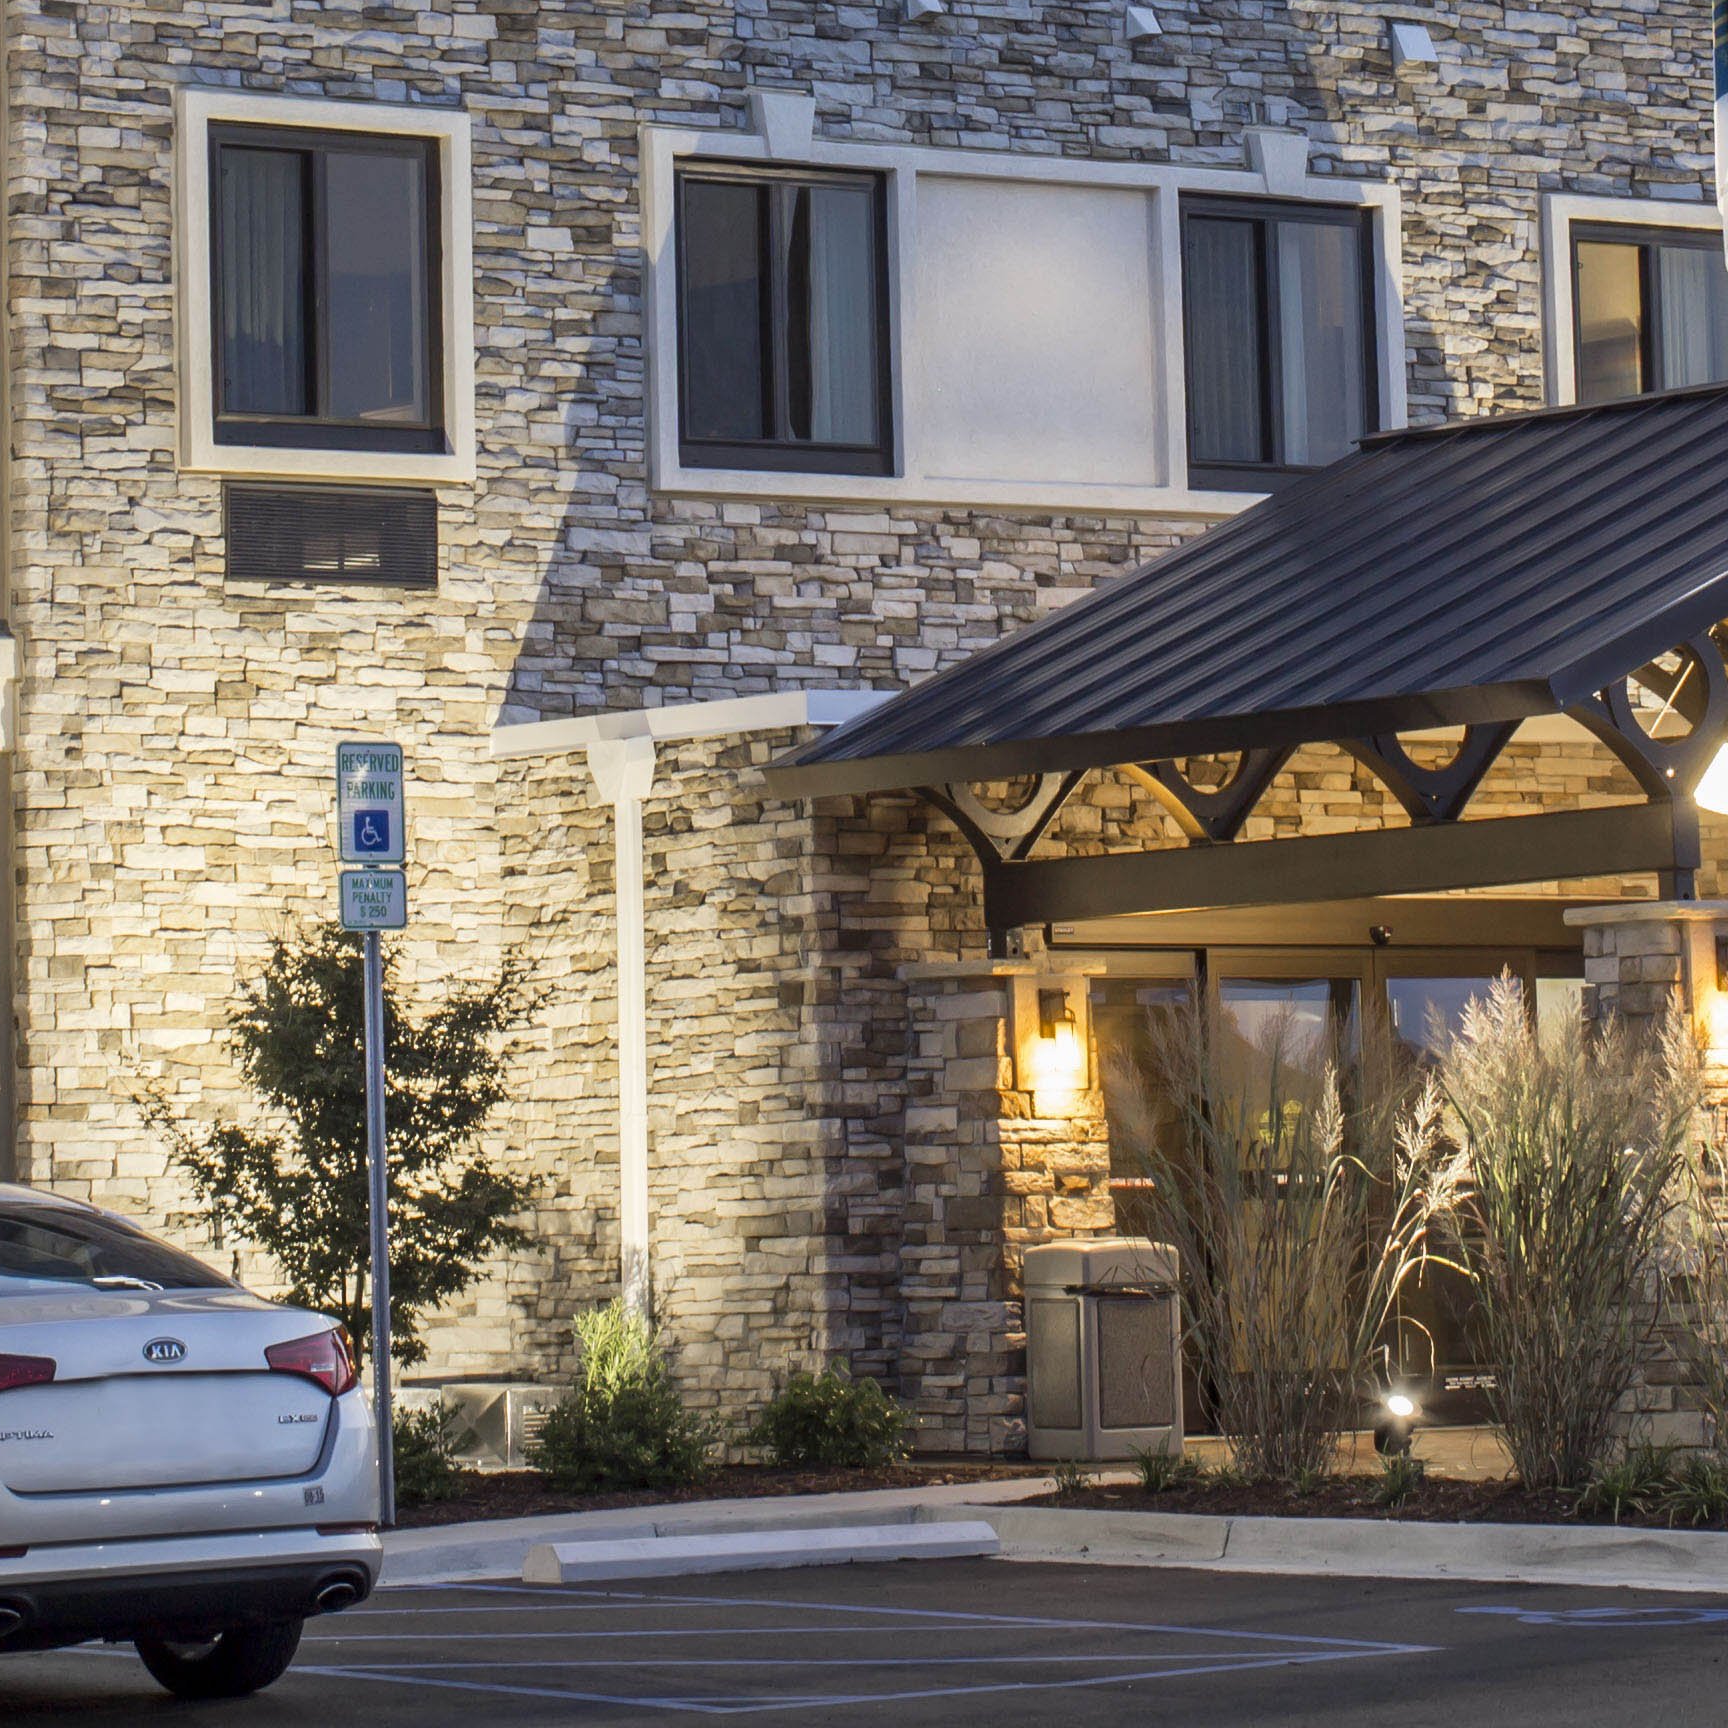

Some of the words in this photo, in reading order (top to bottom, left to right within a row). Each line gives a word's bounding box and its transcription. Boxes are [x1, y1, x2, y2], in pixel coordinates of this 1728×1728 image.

[341, 752, 399, 773] RESERVED
[346, 780, 395, 801] PARKING
[352, 891, 392, 903] PENALTY
[152, 1343, 182, 1359] KIA
